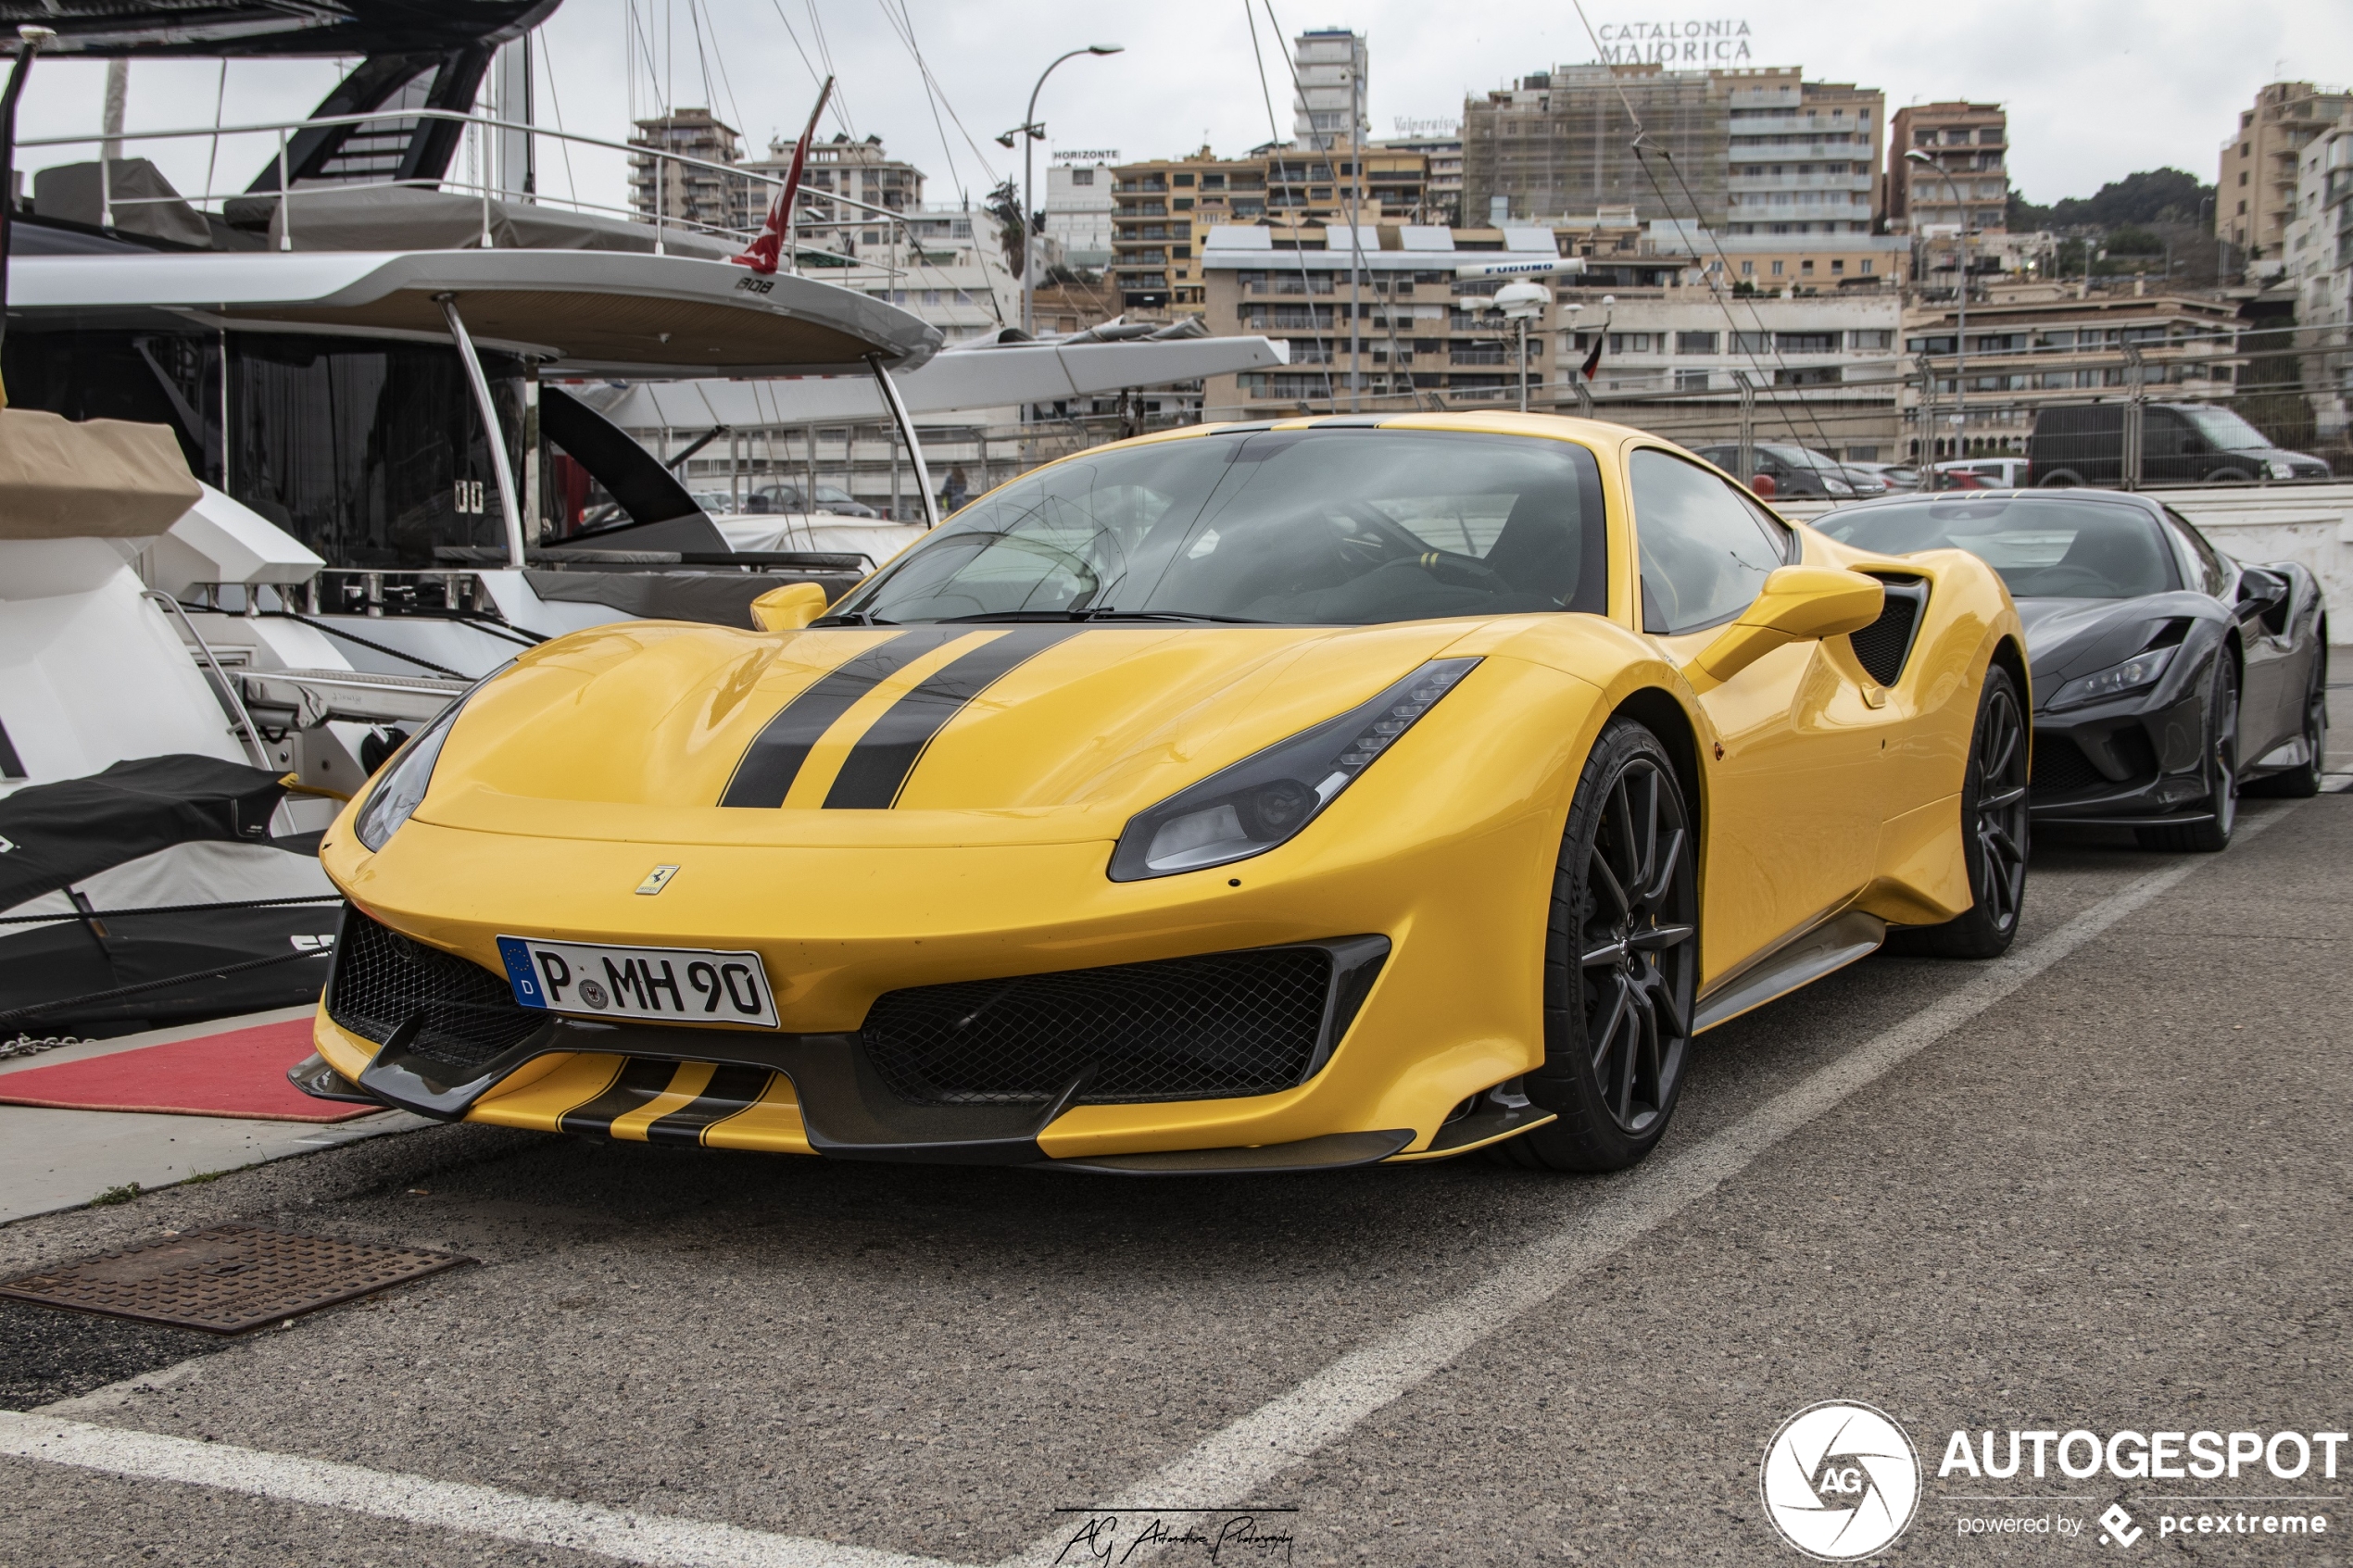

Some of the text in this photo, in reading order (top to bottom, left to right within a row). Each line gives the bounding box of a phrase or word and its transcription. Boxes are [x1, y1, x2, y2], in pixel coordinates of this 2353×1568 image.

[1599, 19, 1751, 41] CATALONIA
[1053, 150, 1118, 159] HORIZONTE
[1485, 263, 1554, 274] FURUNO
[1568, 916, 1579, 1003] MICHELIN
[521, 979, 535, 995] D
[535, 950, 761, 1015] P MH 90
